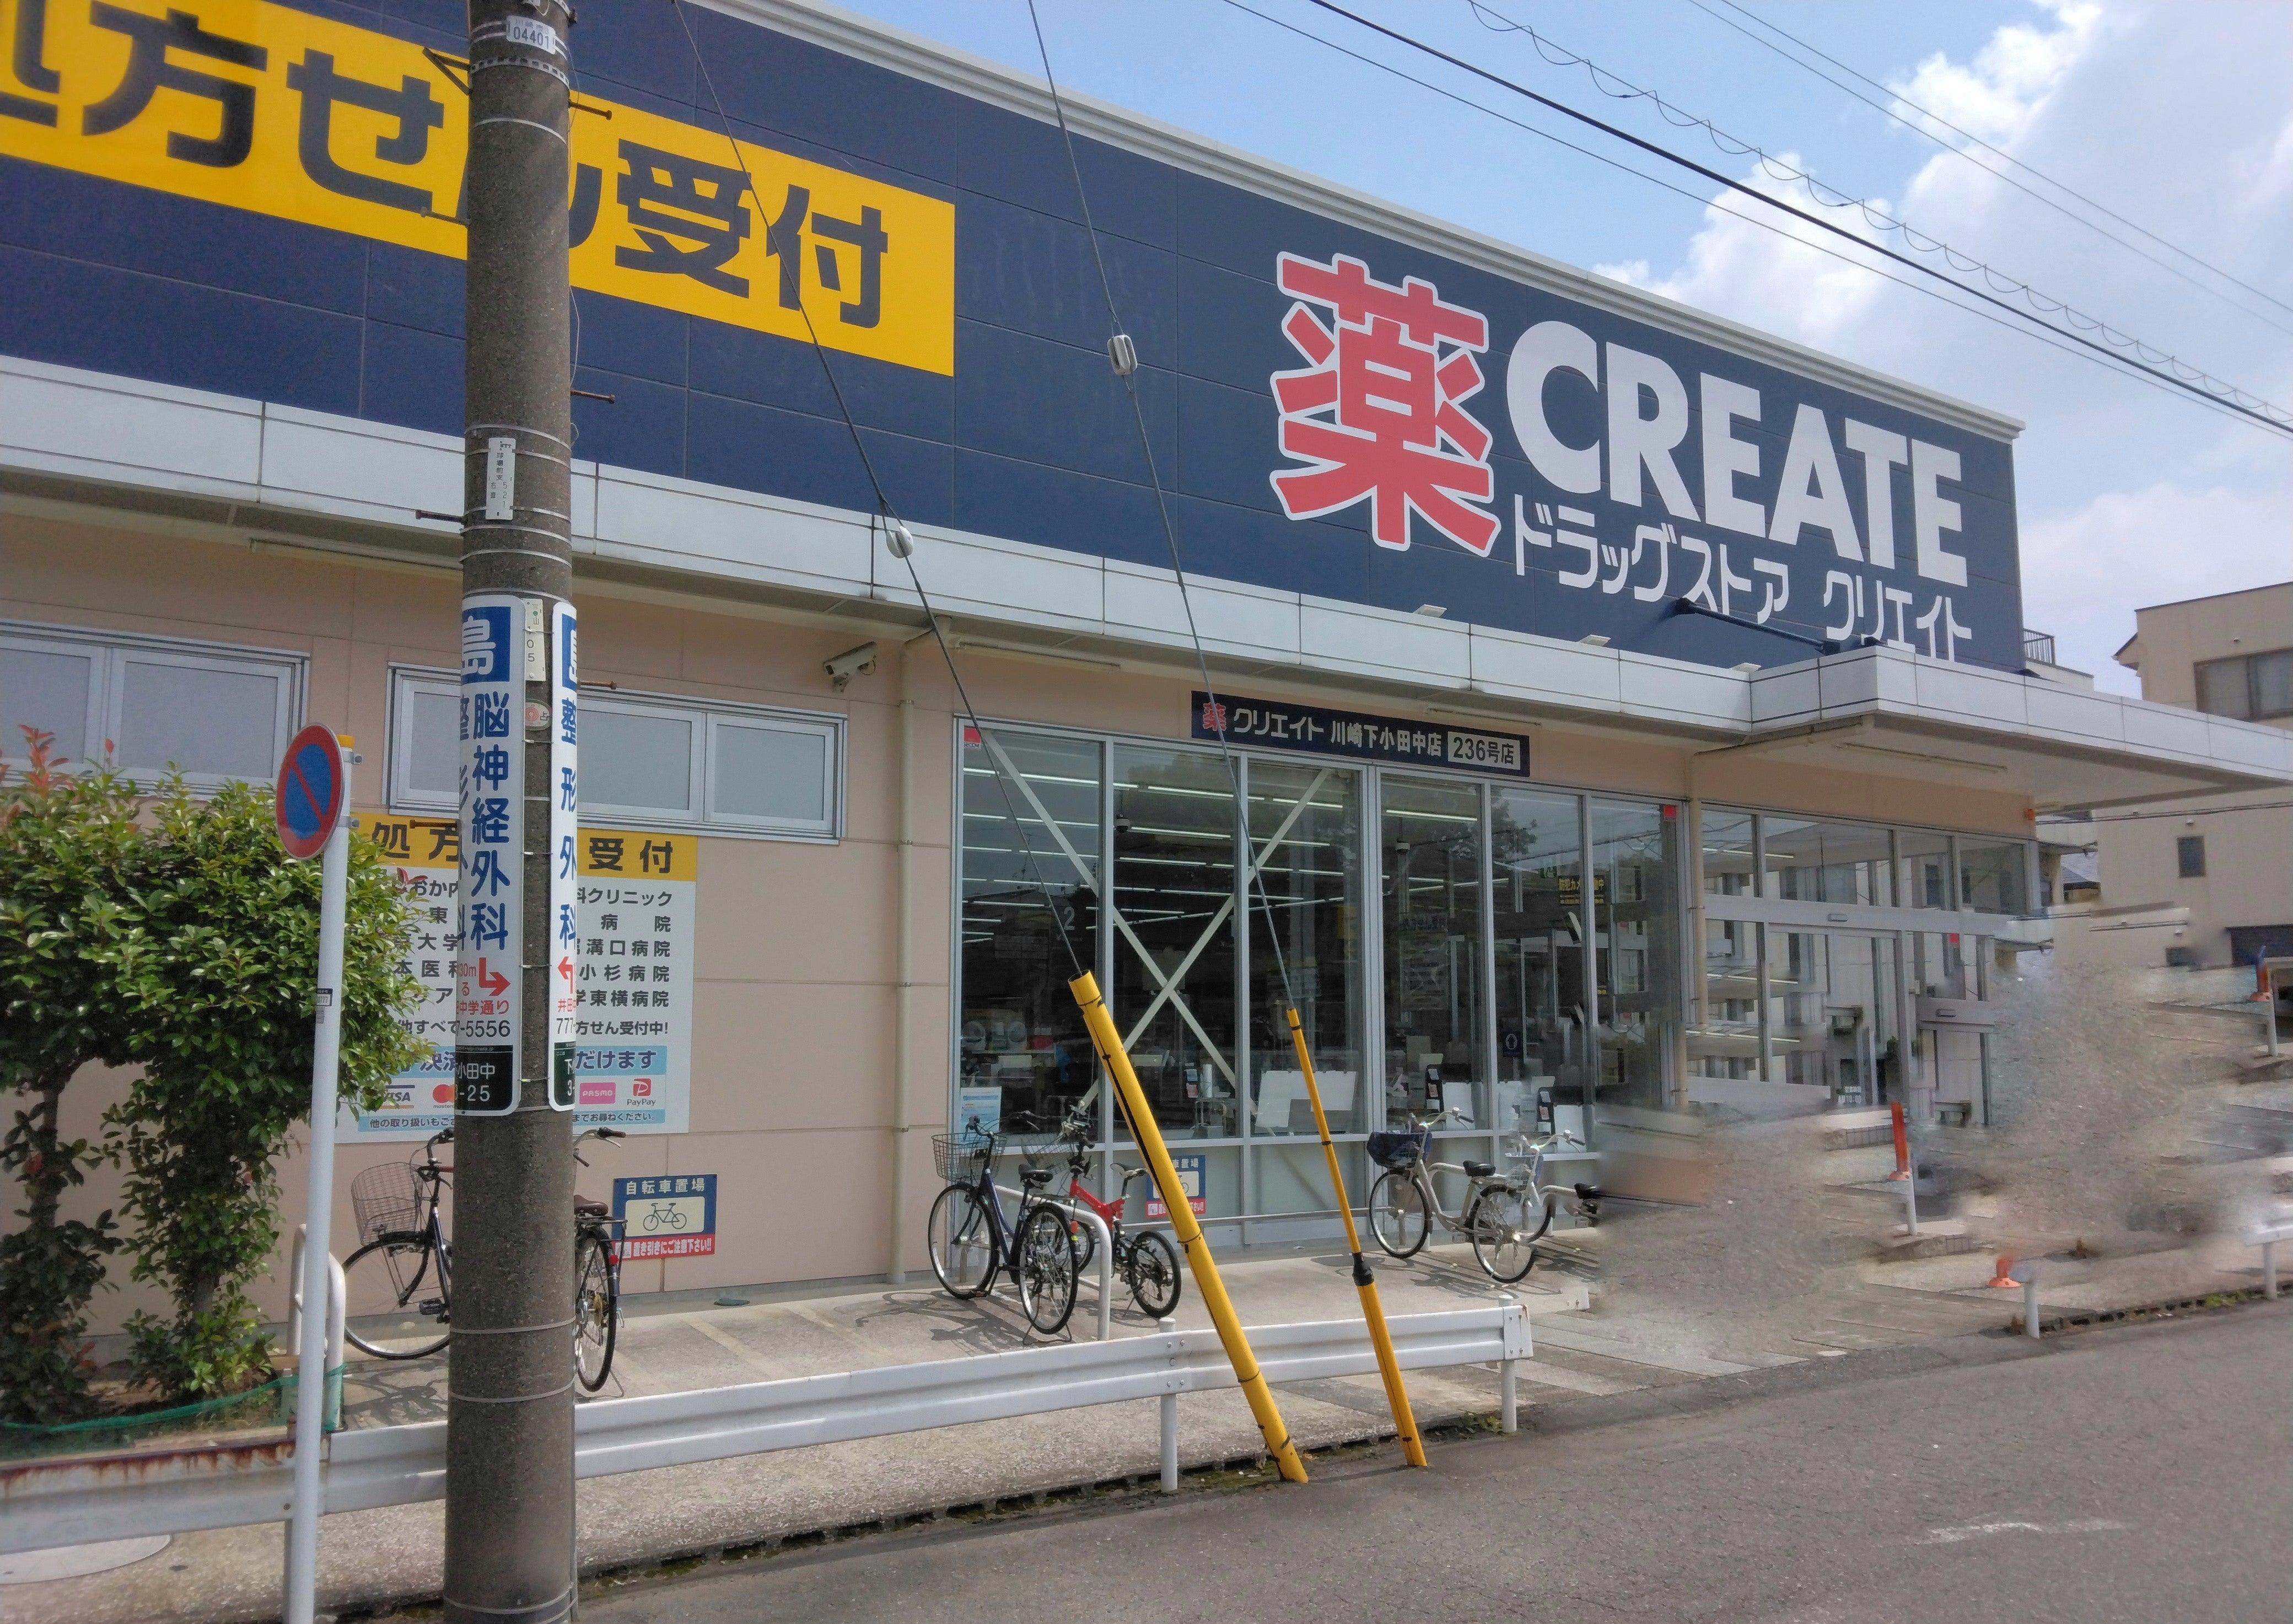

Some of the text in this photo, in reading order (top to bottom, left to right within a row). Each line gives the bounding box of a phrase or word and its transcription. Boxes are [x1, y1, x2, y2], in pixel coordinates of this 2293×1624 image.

[513, 26, 550, 50] 04401
[0, 0, 888, 329] 方せ受付
[1269, 251, 1501, 558] 薬
[1506, 320, 1968, 587] CREATE
[1514, 493, 1972, 662] ドラッグストア クリエイト
[1202, 701, 1514, 766] 薬 クリエイト 川崎下小田中店 236号店
[471, 691, 510, 951] 脳神経外科
[589, 837, 674, 874] 受付
[577, 938, 671, 958] 溝口病院
[579, 964, 670, 982] 小杉病院
[456, 999, 510, 1016] 中学通り
[455, 1062, 496, 1080] 小田中
[576, 1050, 656, 1069] だけます
[626, 1098, 656, 1107] PayPay
[626, 1177, 706, 1195] 自転車置場
